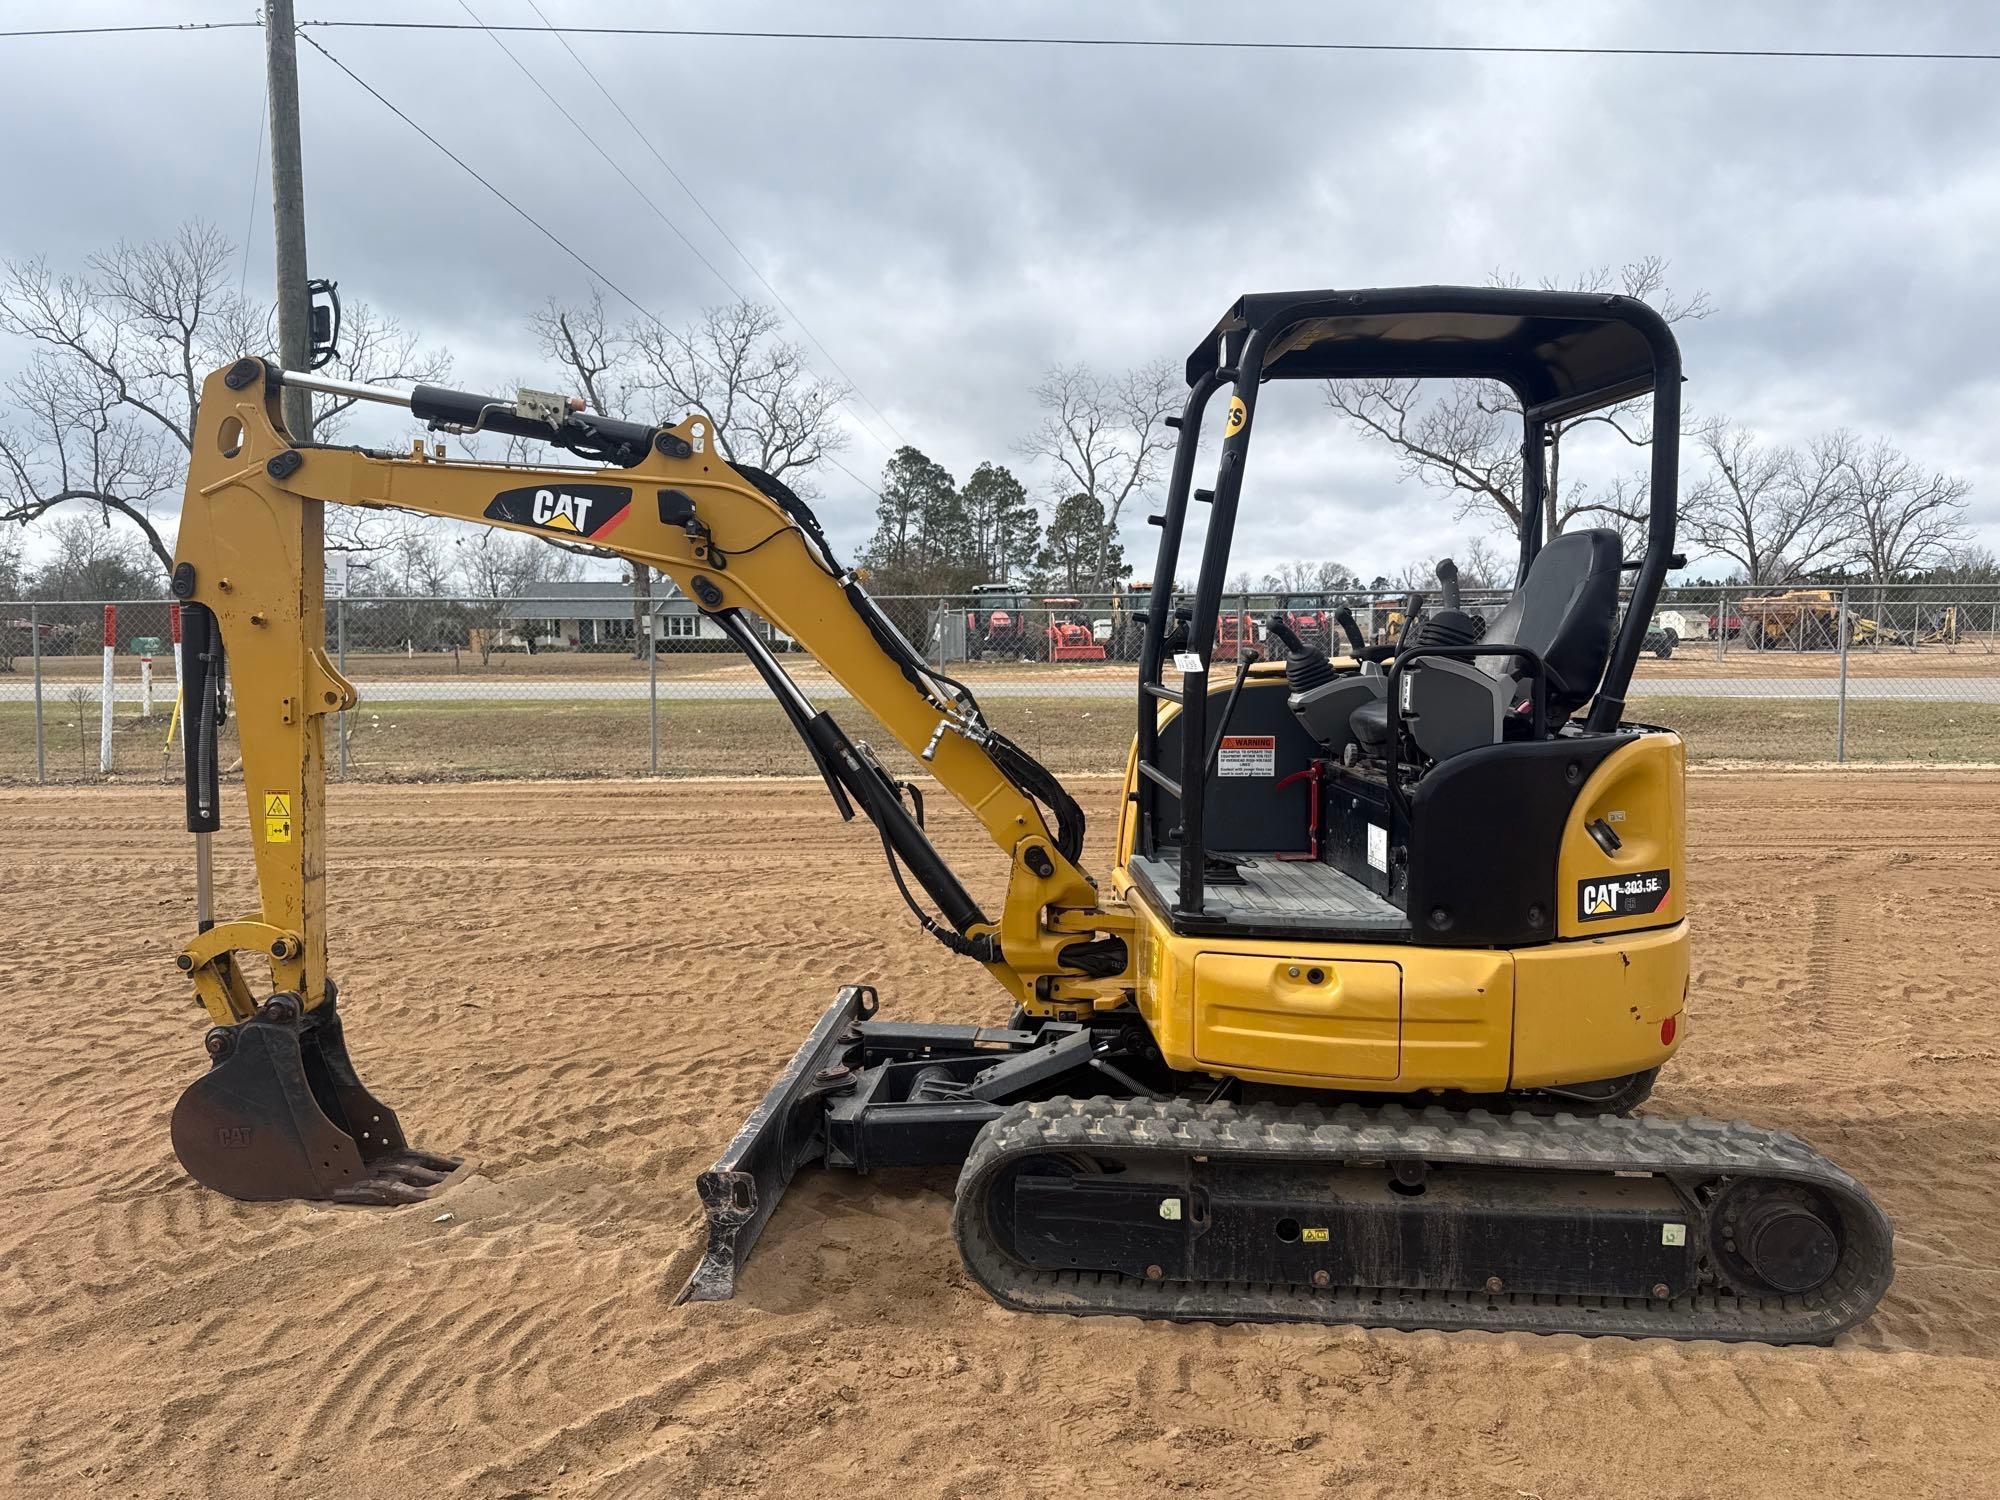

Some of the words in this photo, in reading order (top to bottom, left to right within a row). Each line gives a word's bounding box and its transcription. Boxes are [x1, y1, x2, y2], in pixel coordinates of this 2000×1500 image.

[532, 489, 593, 532] CAT
[1236, 739, 1271, 747] WARNING
[1584, 883, 1619, 914] CAT
[219, 1127, 251, 1146] CAT
